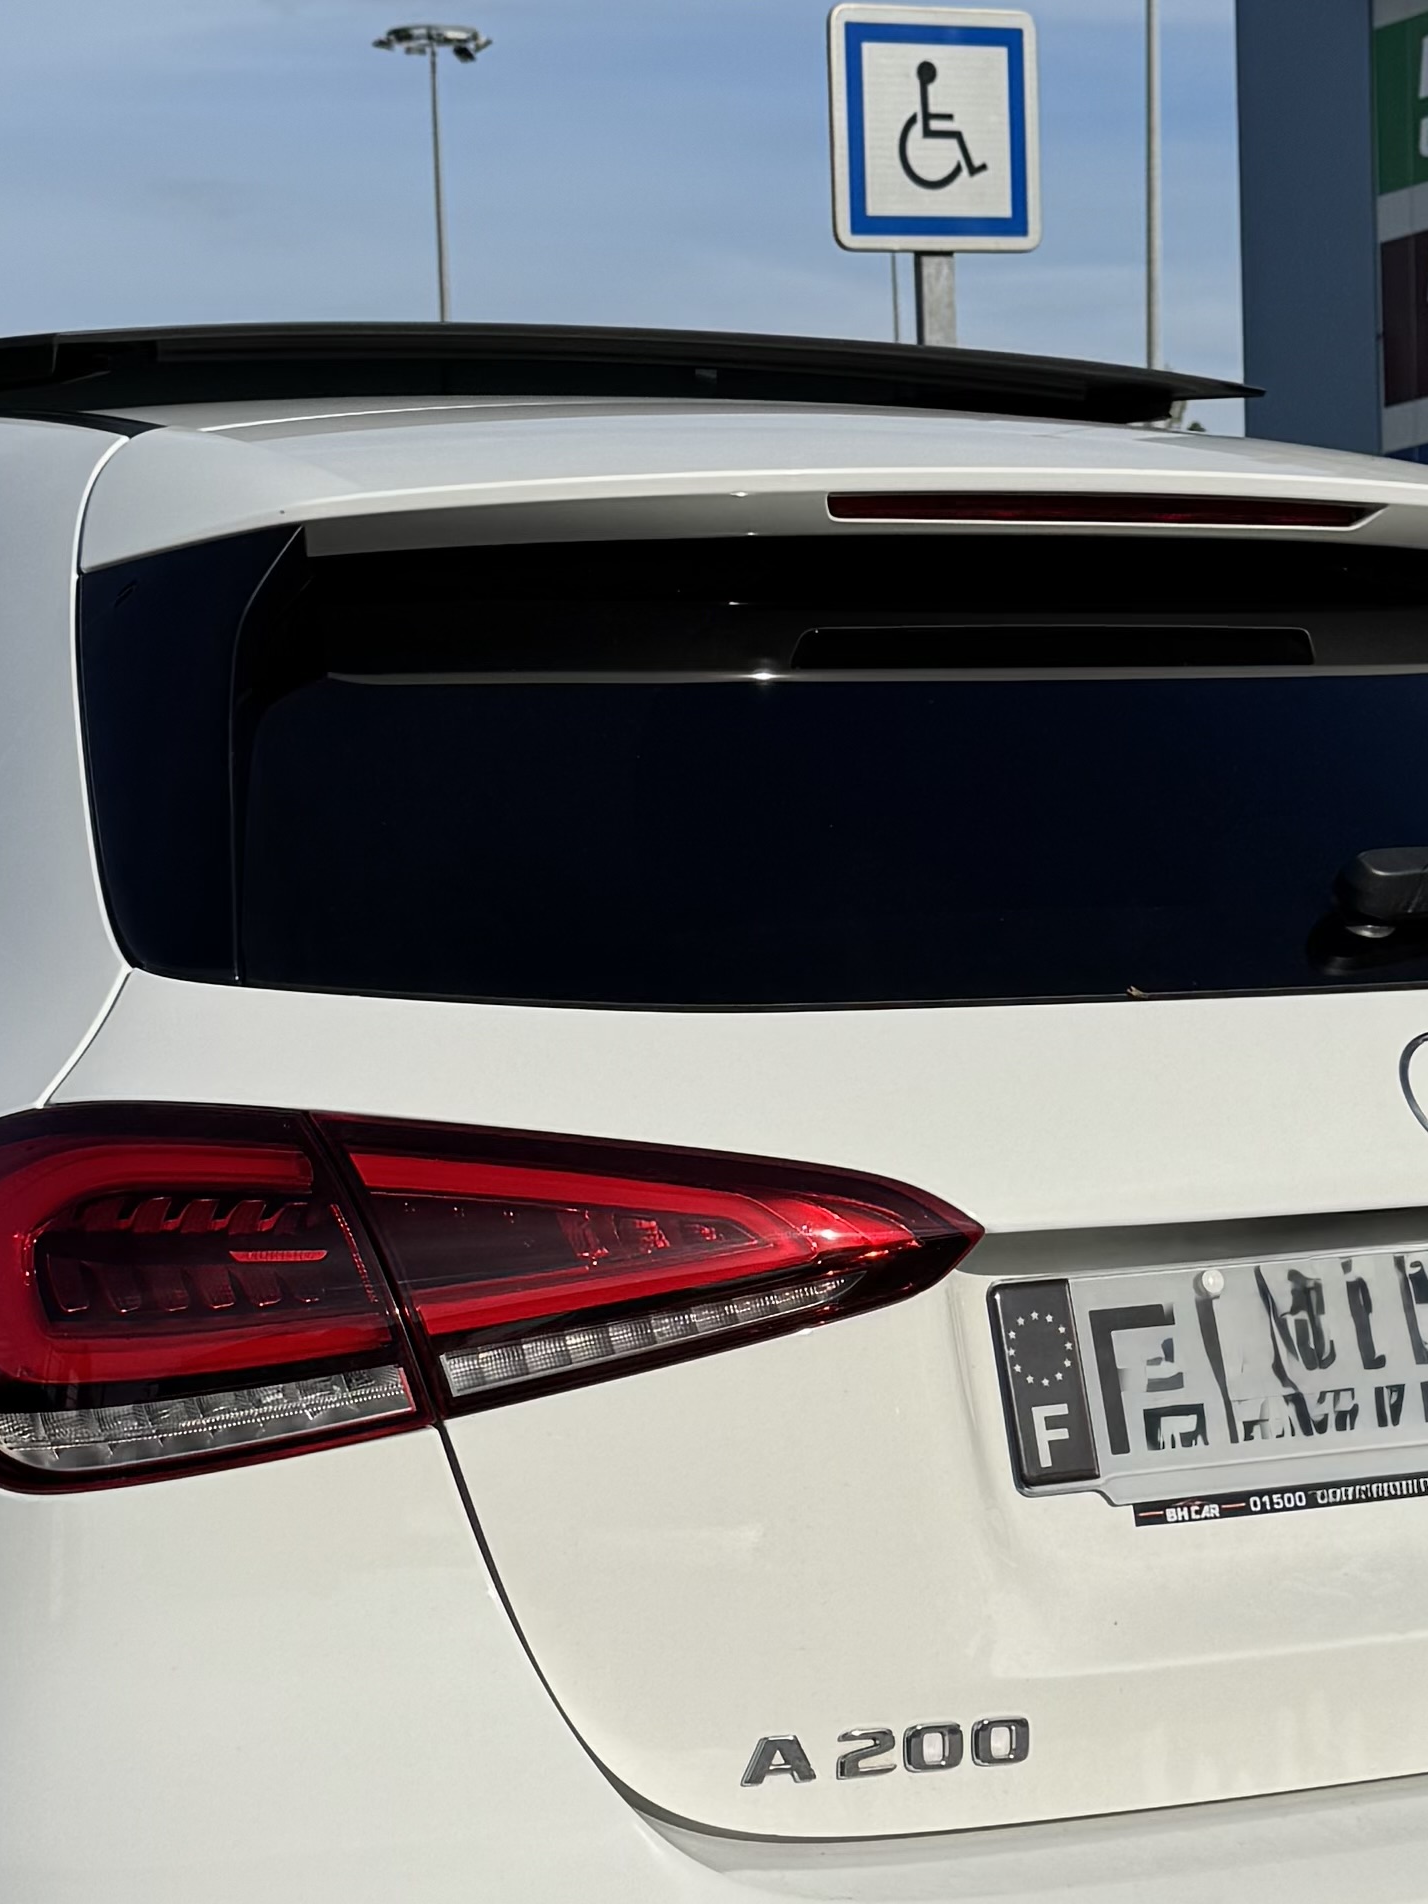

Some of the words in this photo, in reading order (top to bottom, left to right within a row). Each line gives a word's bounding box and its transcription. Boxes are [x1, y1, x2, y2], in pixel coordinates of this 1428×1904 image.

[1031, 1403, 1070, 1467] F
[1249, 1491, 1307, 1512] 01500
[740, 1734, 817, 1787] A
[836, 1716, 1030, 1780] 200
